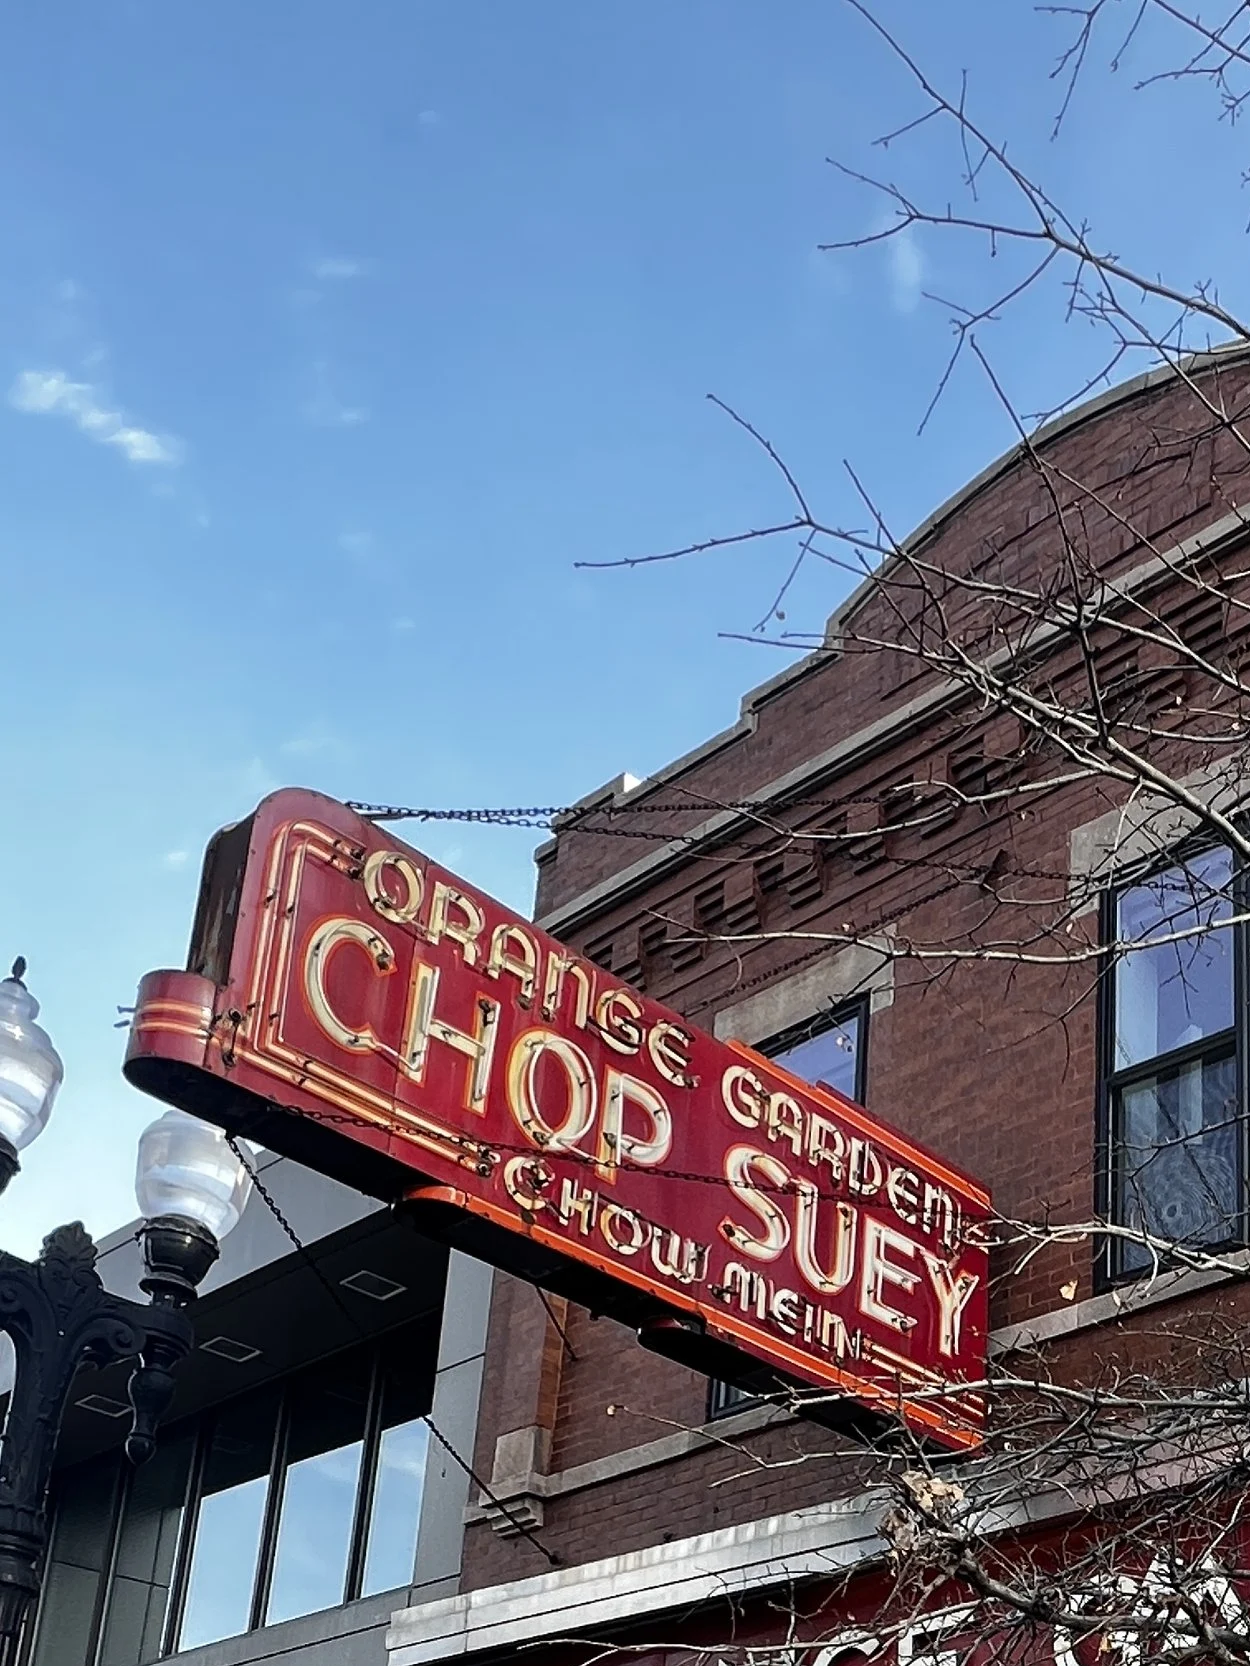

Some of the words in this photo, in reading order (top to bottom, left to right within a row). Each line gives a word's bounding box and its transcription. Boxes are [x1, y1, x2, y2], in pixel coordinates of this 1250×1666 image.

[303, 914, 673, 1185] CHOP
[718, 1143, 981, 1358] SUEY
[363, 850, 698, 1088] ORANGE
[722, 1065, 963, 1254] GARDEN
[503, 1155, 712, 1286] CHOW
[722, 1262, 862, 1362] MEIN
